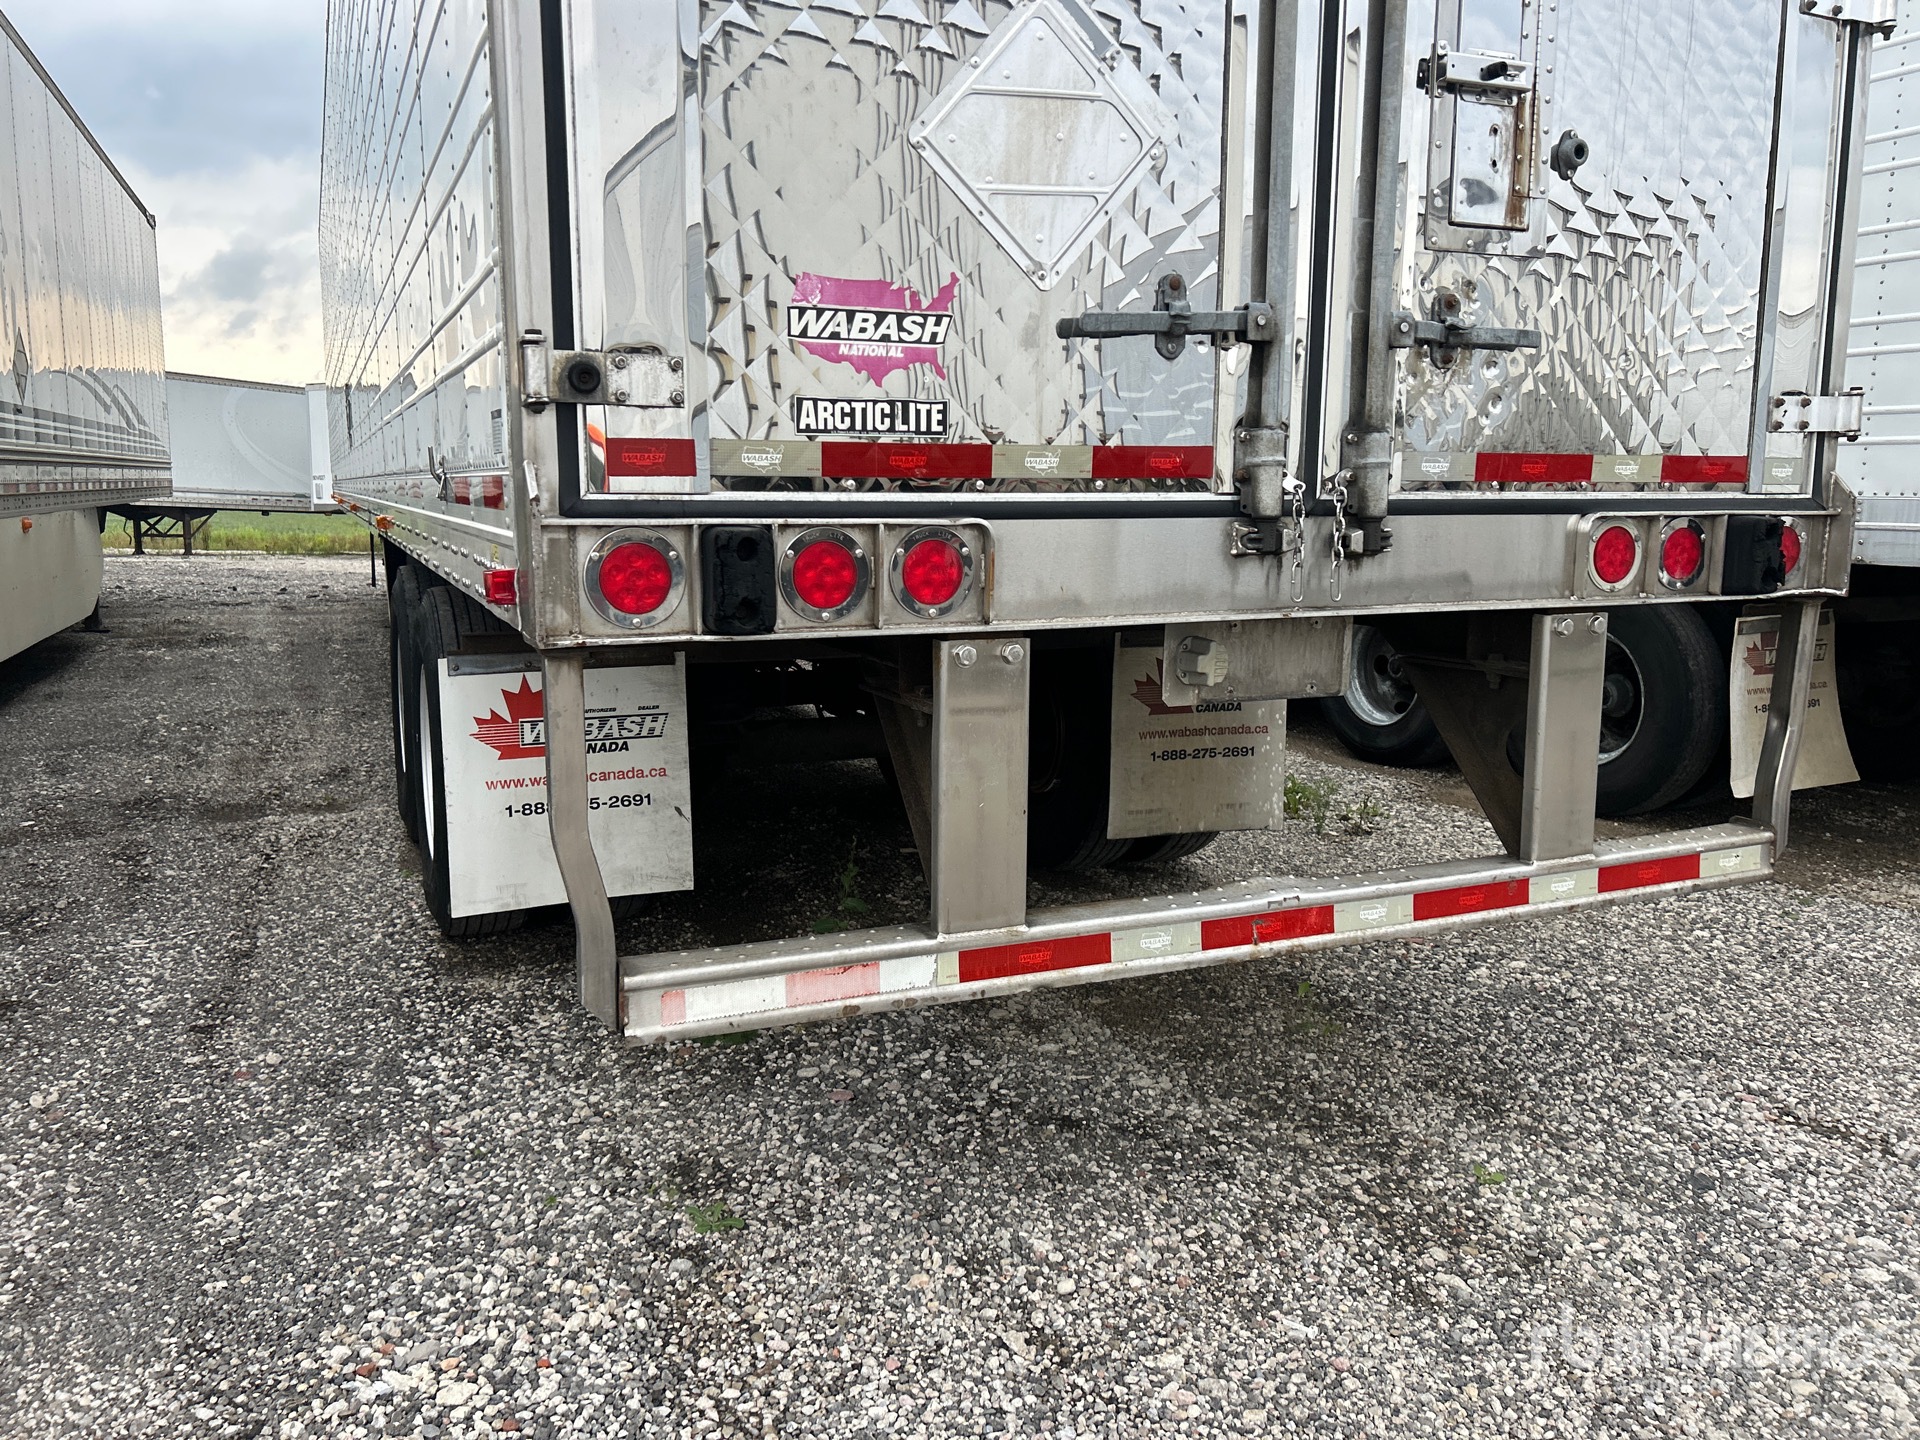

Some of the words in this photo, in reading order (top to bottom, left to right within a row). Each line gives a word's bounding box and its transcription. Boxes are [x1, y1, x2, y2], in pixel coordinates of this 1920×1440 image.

[789, 308, 950, 343] WABASH
[839, 343, 904, 358] NATIONAL
[799, 399, 890, 431] ARCTIC
[894, 401, 944, 433] LITE
[622, 454, 666, 463] WABASH
[742, 454, 782, 462] WABASH
[1025, 458, 1059, 466] WABASH
[1196, 702, 1242, 714] CANADA
[523, 715, 667, 744] WBASH
[1138, 724, 1269, 741] www.wabashcanada.ca
[586, 741, 629, 754] NADA
[1150, 746, 1256, 762] 1-888-275-2691
[485, 766, 667, 790] www.wacanada.ca
[505, 794, 652, 818] 1-885-2691
